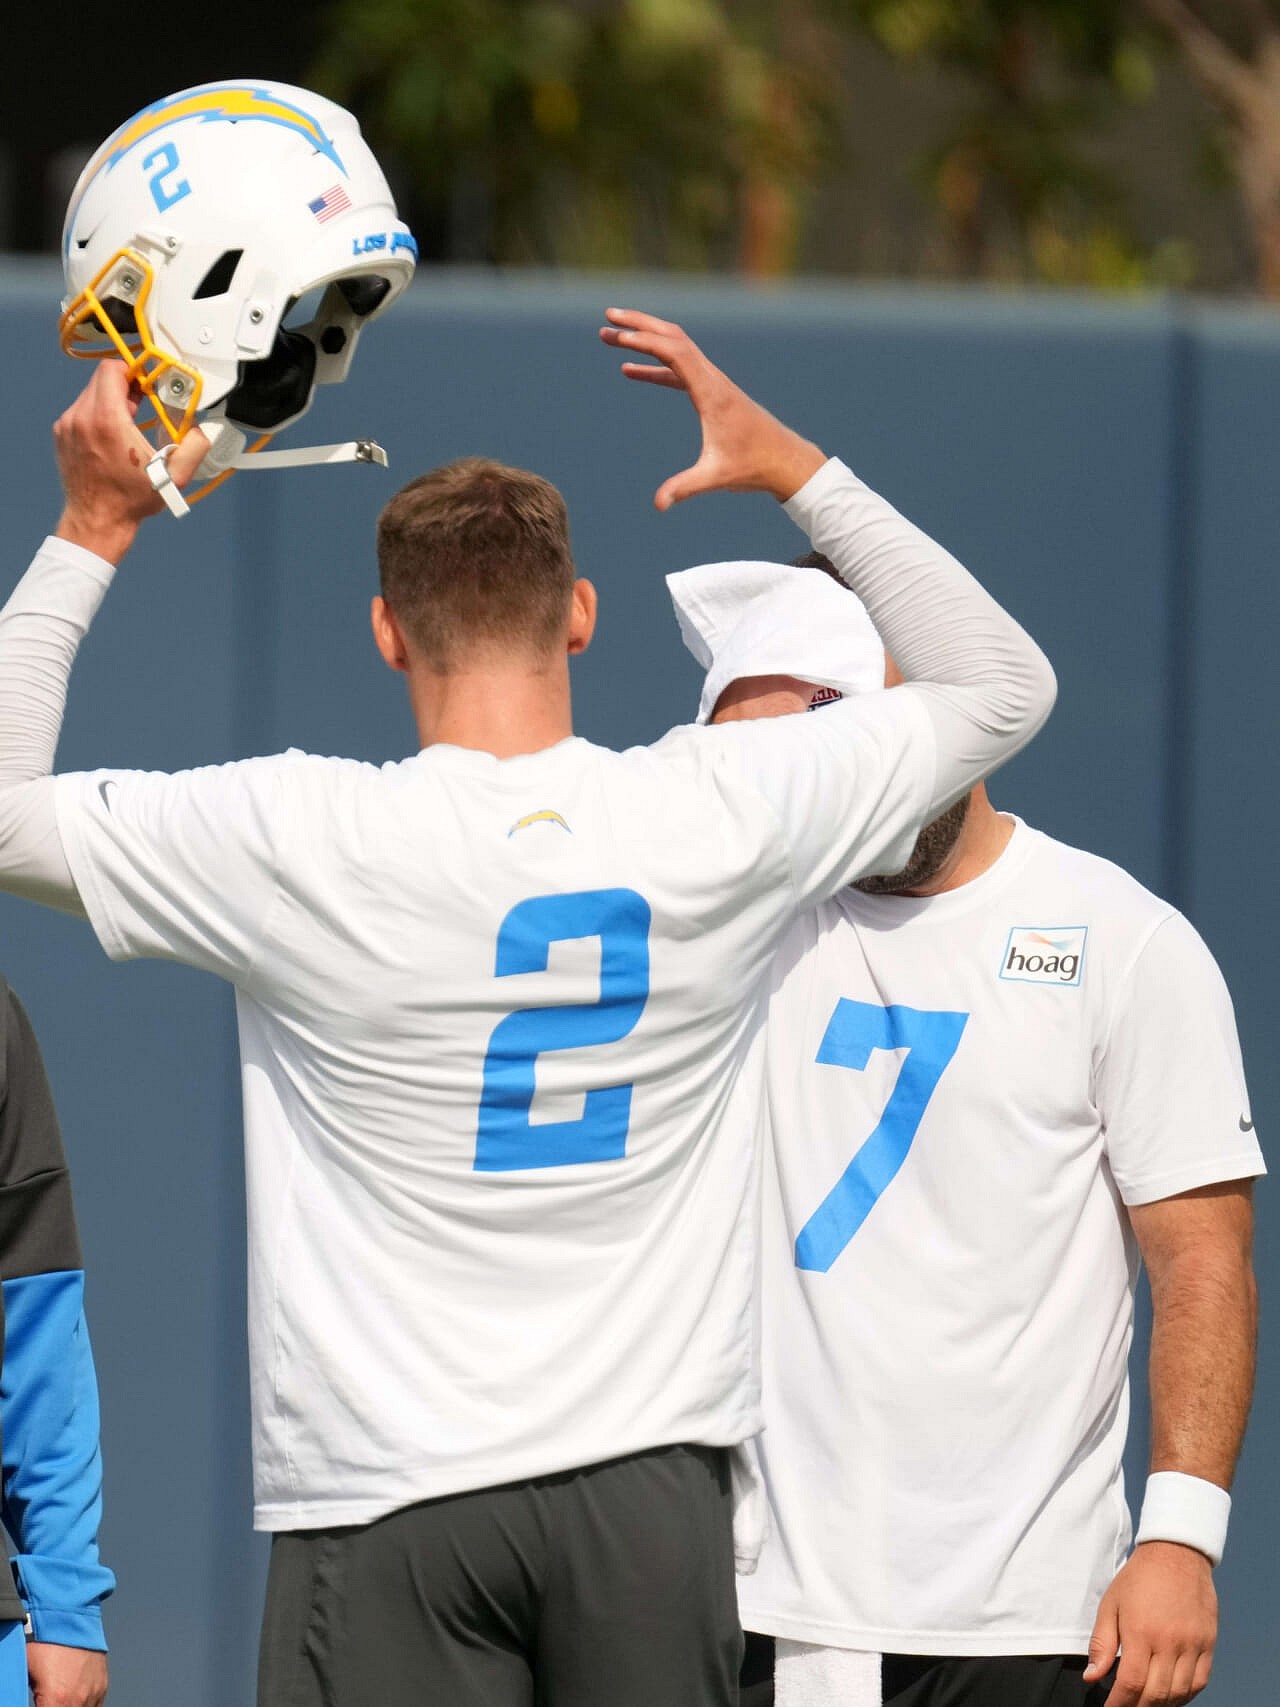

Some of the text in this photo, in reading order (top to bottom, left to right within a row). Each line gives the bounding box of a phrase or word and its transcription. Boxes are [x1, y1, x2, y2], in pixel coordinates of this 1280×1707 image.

[143, 142, 192, 213] 2
[473, 887, 652, 1171] 2
[1006, 946, 1079, 981] hoag
[795, 996, 970, 1273] 7
